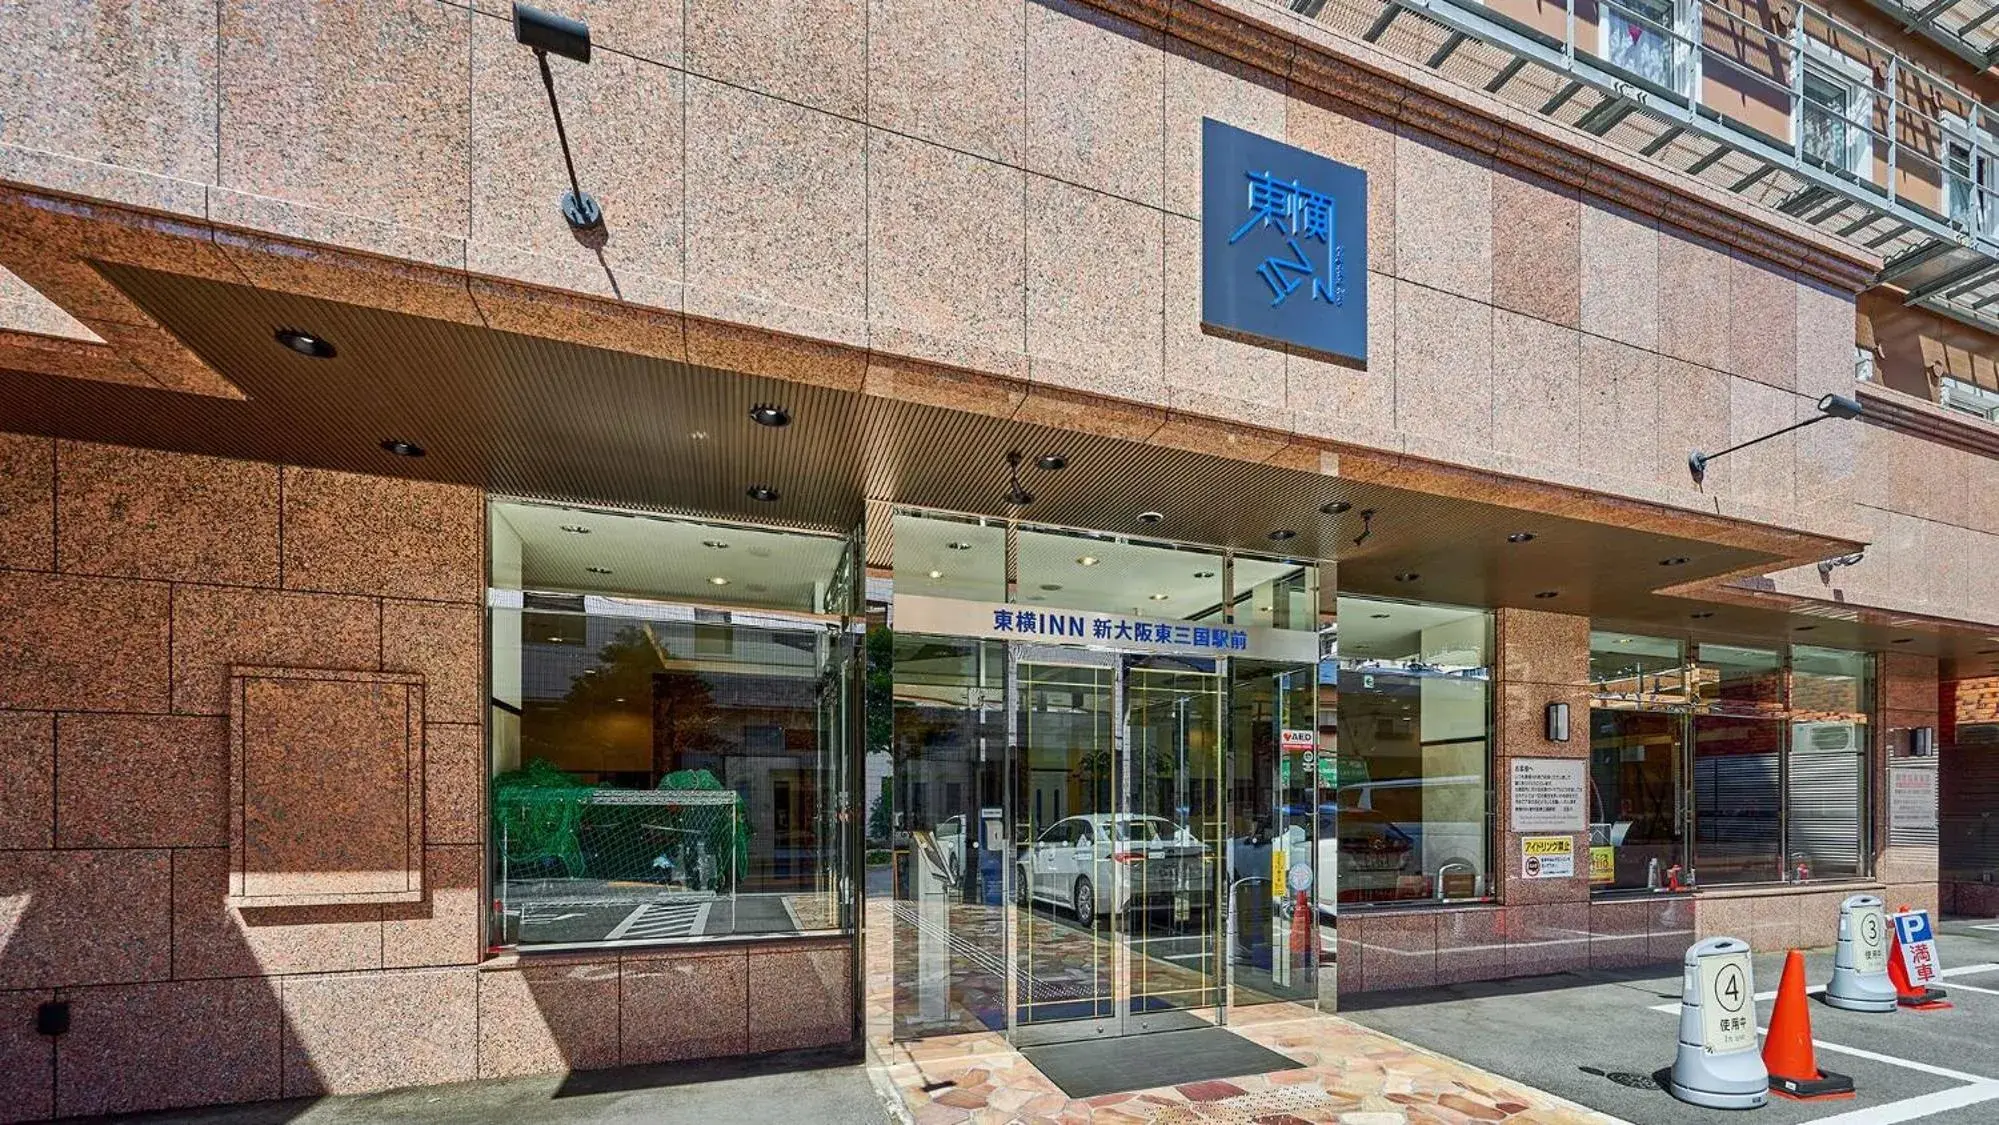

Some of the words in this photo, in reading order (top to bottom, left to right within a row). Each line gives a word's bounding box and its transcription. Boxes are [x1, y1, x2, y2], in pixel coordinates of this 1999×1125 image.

[993, 608, 1085, 638] 東横INN
[1092, 617, 1248, 650] 新大阪東三国駅前
[1292, 732, 1312, 741] AED
[1901, 914, 1925, 944] P
[1909, 943, 1936, 982] 満車
[1720, 1017, 1747, 1032] 使用中
